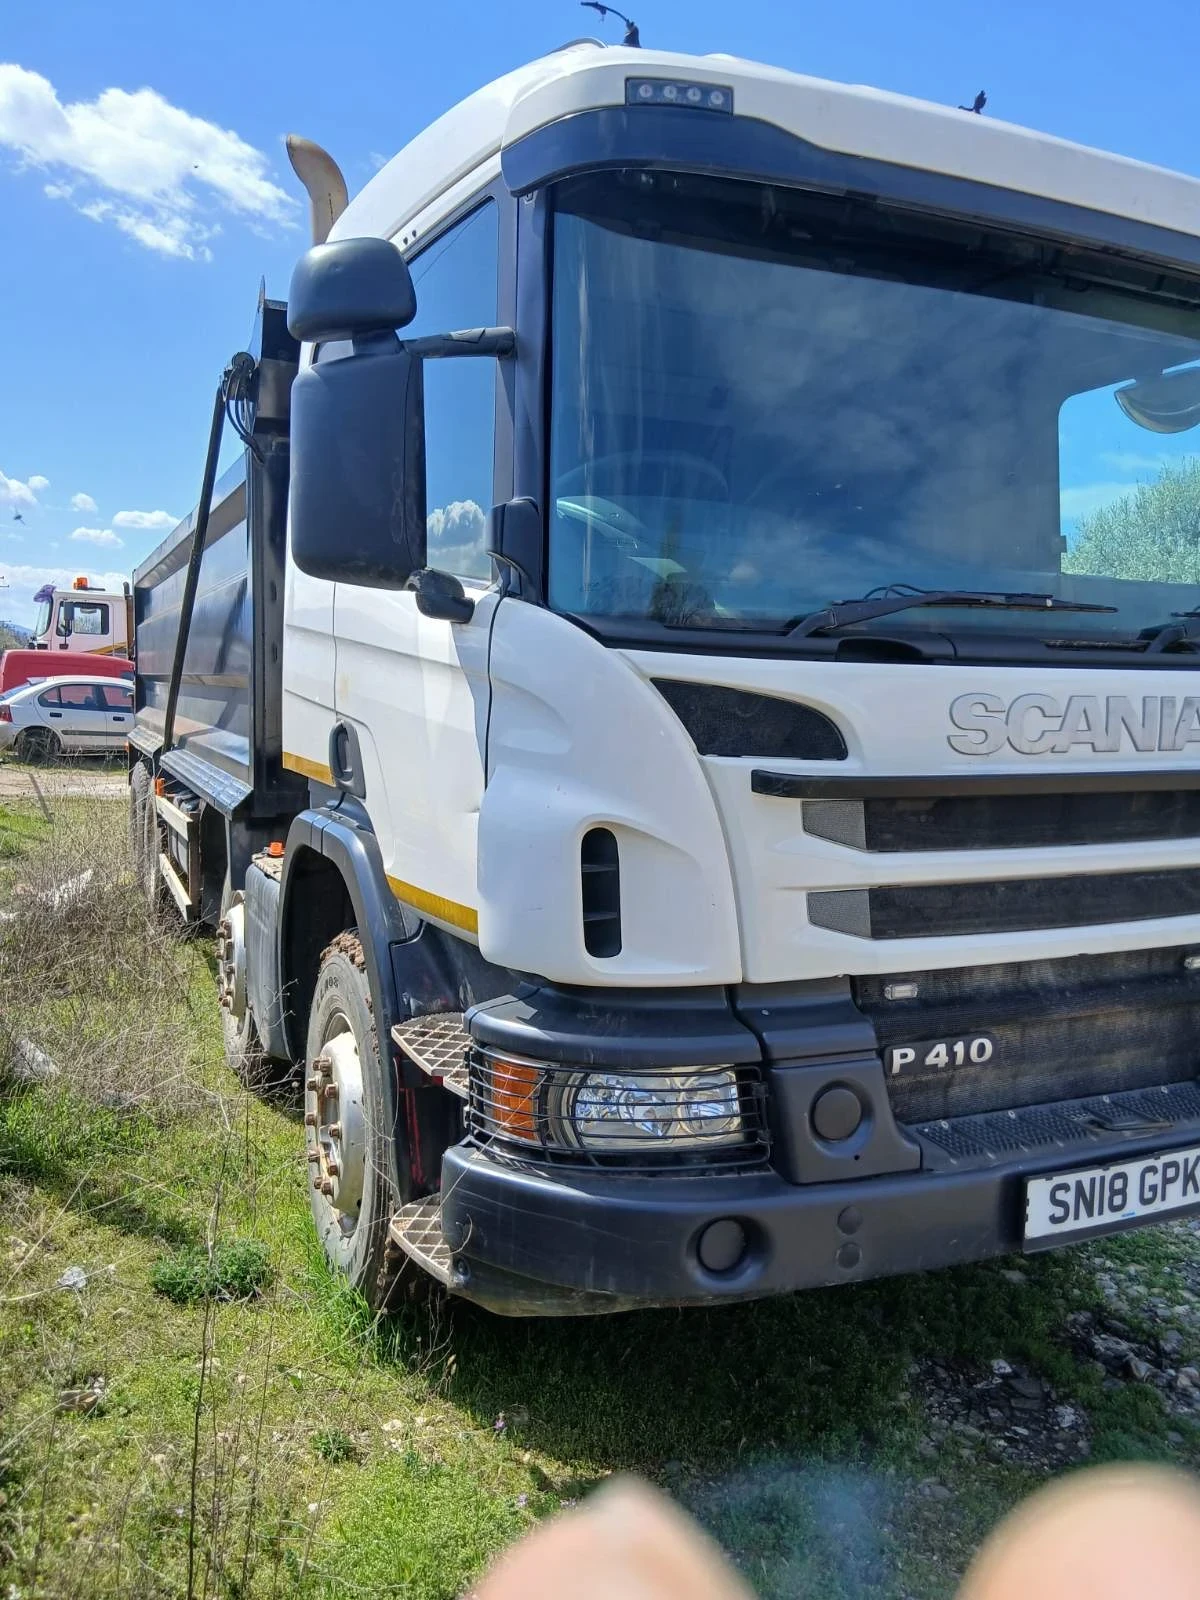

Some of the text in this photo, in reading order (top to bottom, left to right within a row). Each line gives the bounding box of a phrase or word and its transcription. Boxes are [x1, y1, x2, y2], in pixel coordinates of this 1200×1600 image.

[892, 1038, 993, 1074] P 410
[1048, 1155, 1200, 1225] SN18 GPK
